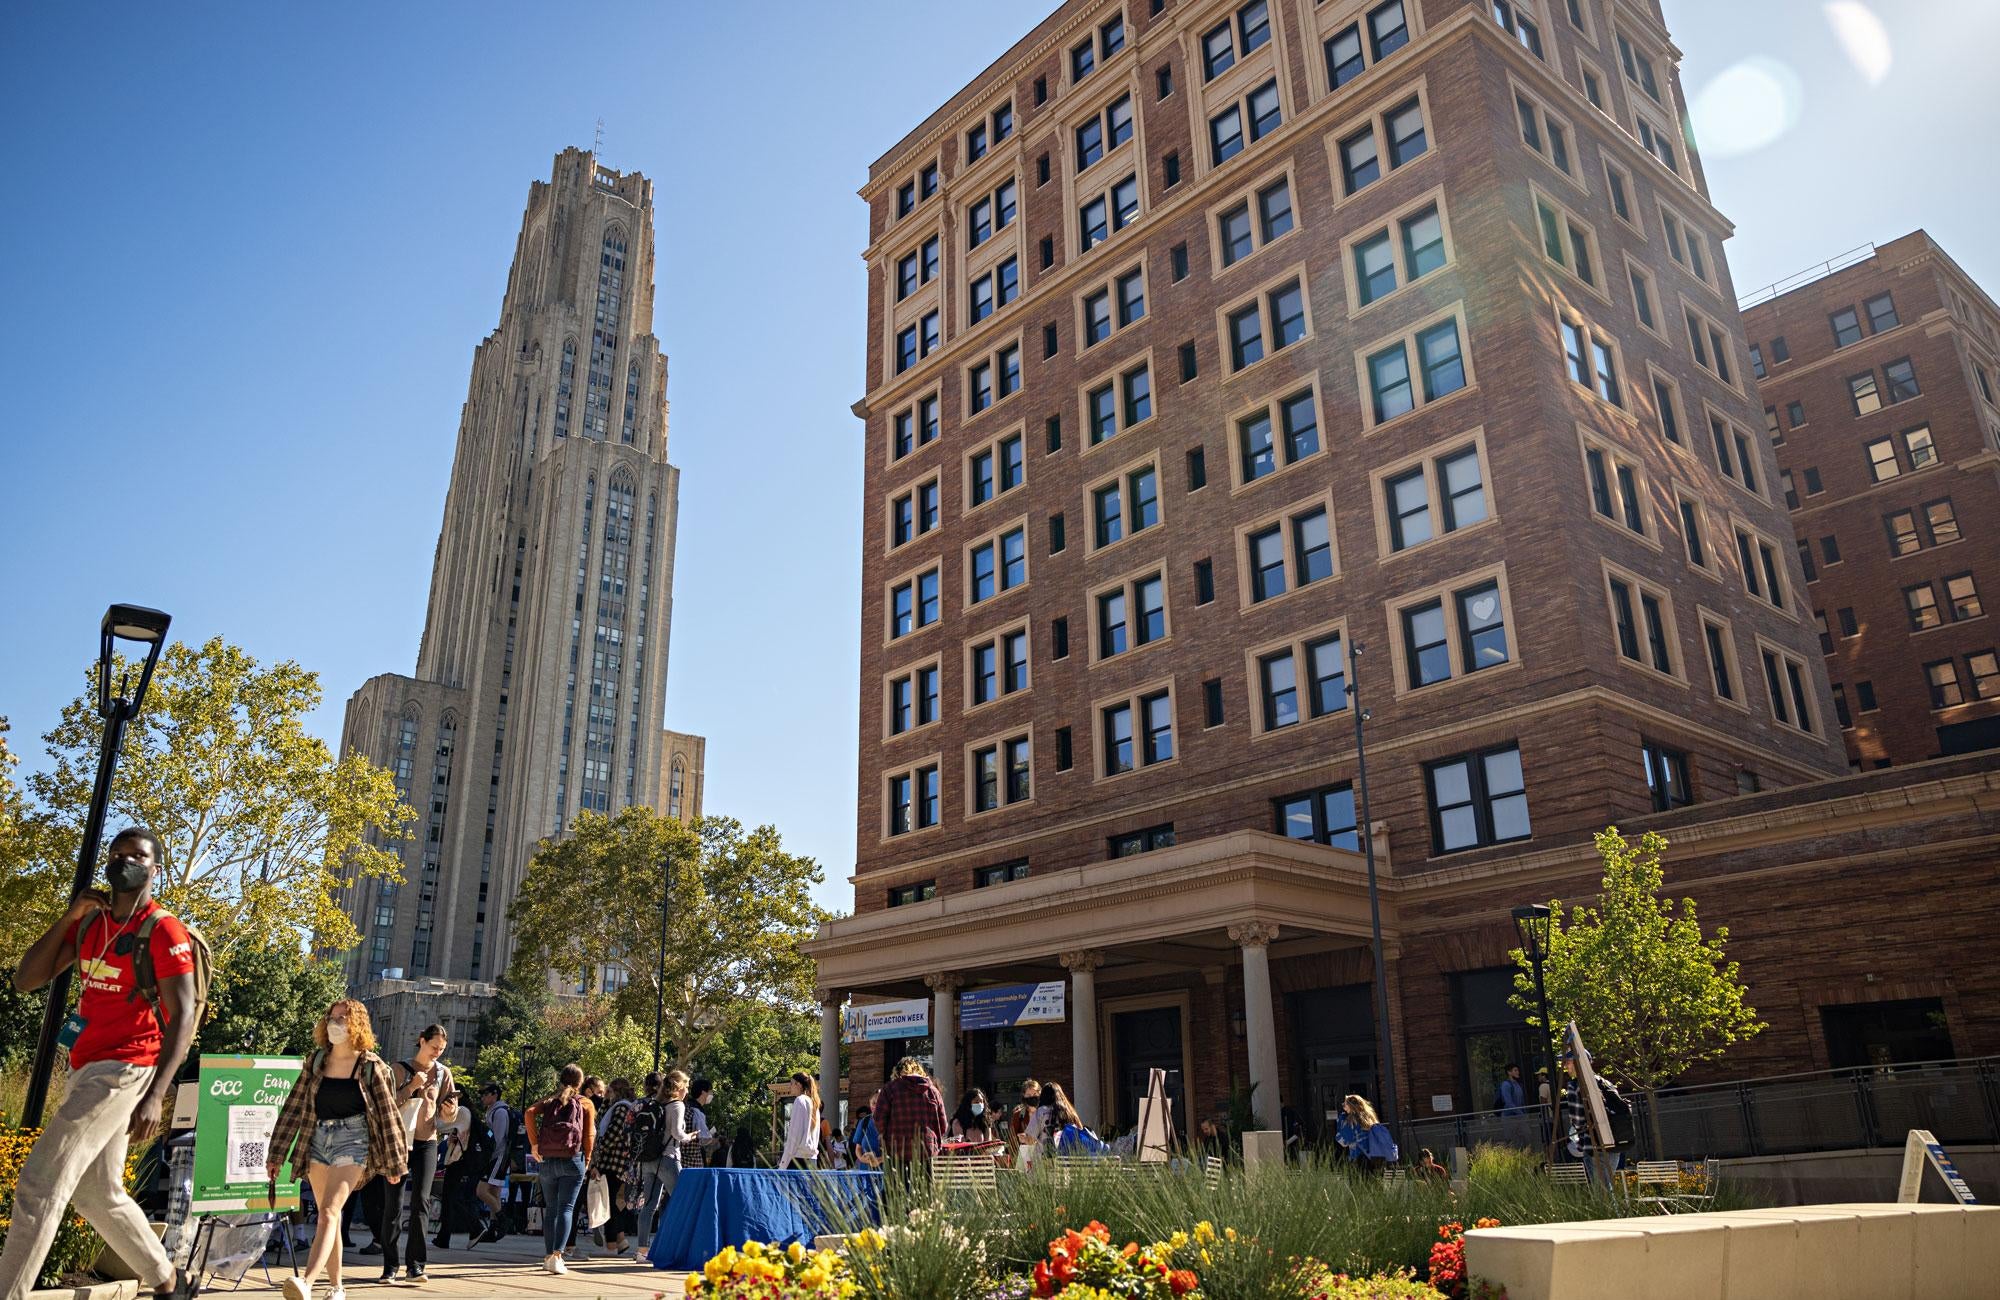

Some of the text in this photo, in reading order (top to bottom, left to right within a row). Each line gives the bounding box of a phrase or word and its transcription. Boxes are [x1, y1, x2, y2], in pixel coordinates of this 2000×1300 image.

[868, 1018, 883, 1026] CIVIC
[884, 1015, 906, 1024] ACTION
[907, 1013, 925, 1021] WEEK
[210, 1080, 243, 1096] OCC
[263, 1073, 291, 1090] Earn
